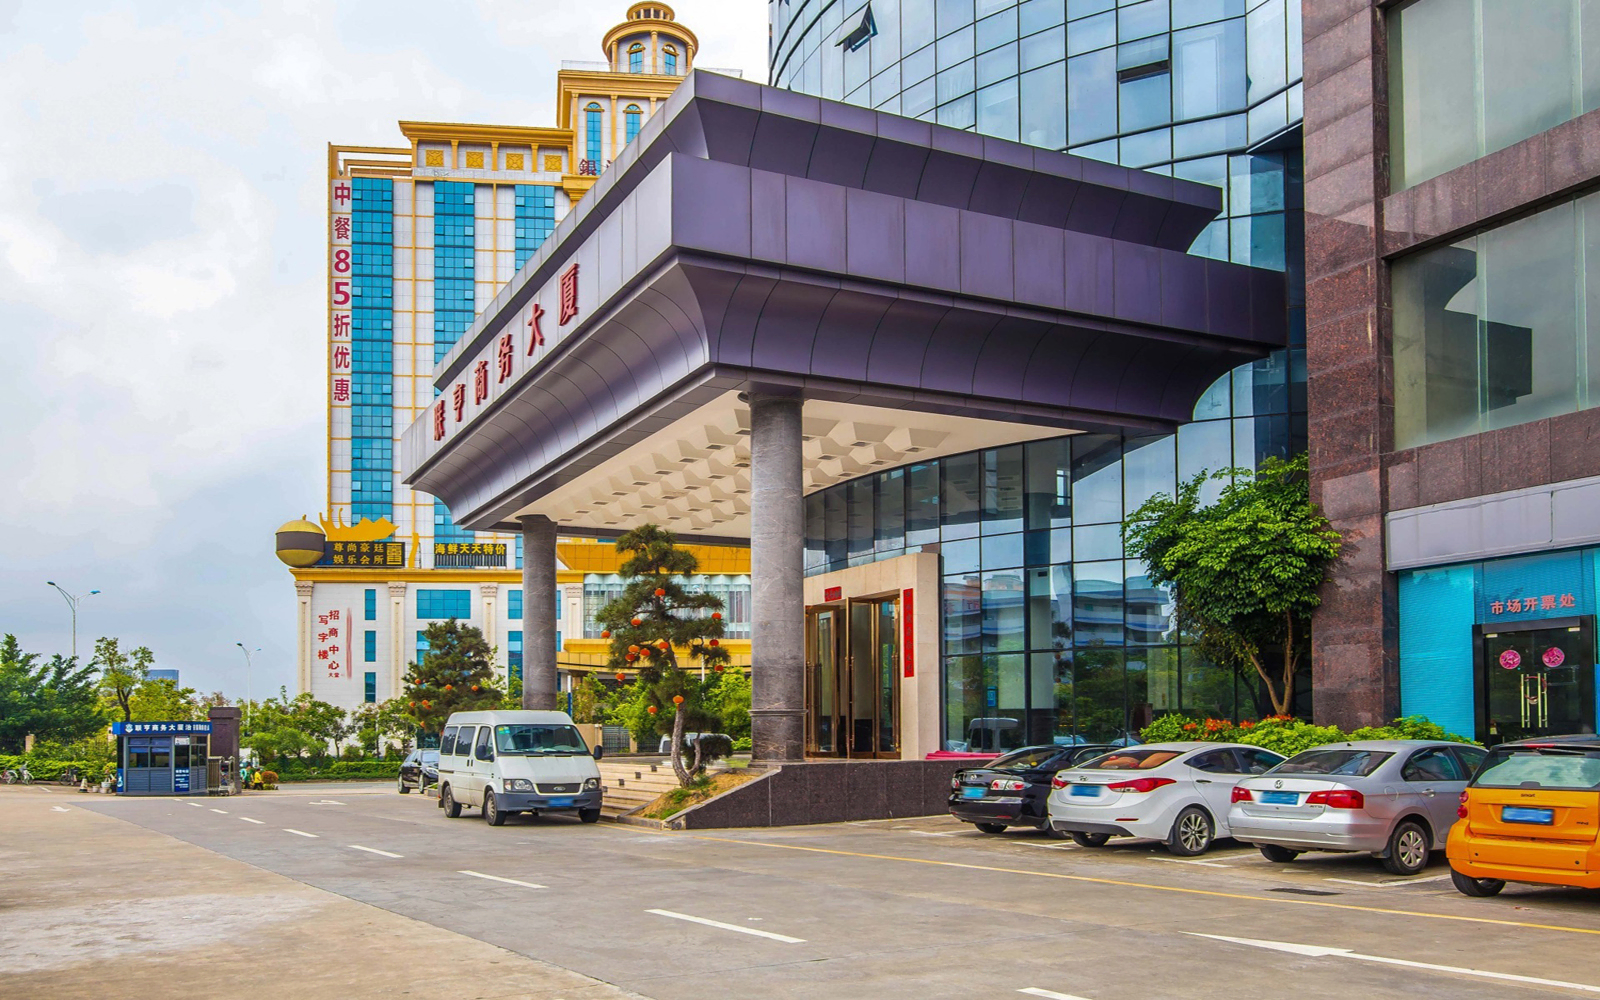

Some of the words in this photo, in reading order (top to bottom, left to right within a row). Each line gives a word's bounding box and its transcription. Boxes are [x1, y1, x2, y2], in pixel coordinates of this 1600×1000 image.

[333, 182, 351, 402] 中餐85折优惠
[434, 543, 506, 555] 海鲜天天特价
[333, 554, 385, 565] 娱乐会所
[1490, 593, 1576, 615] 市场开票处
